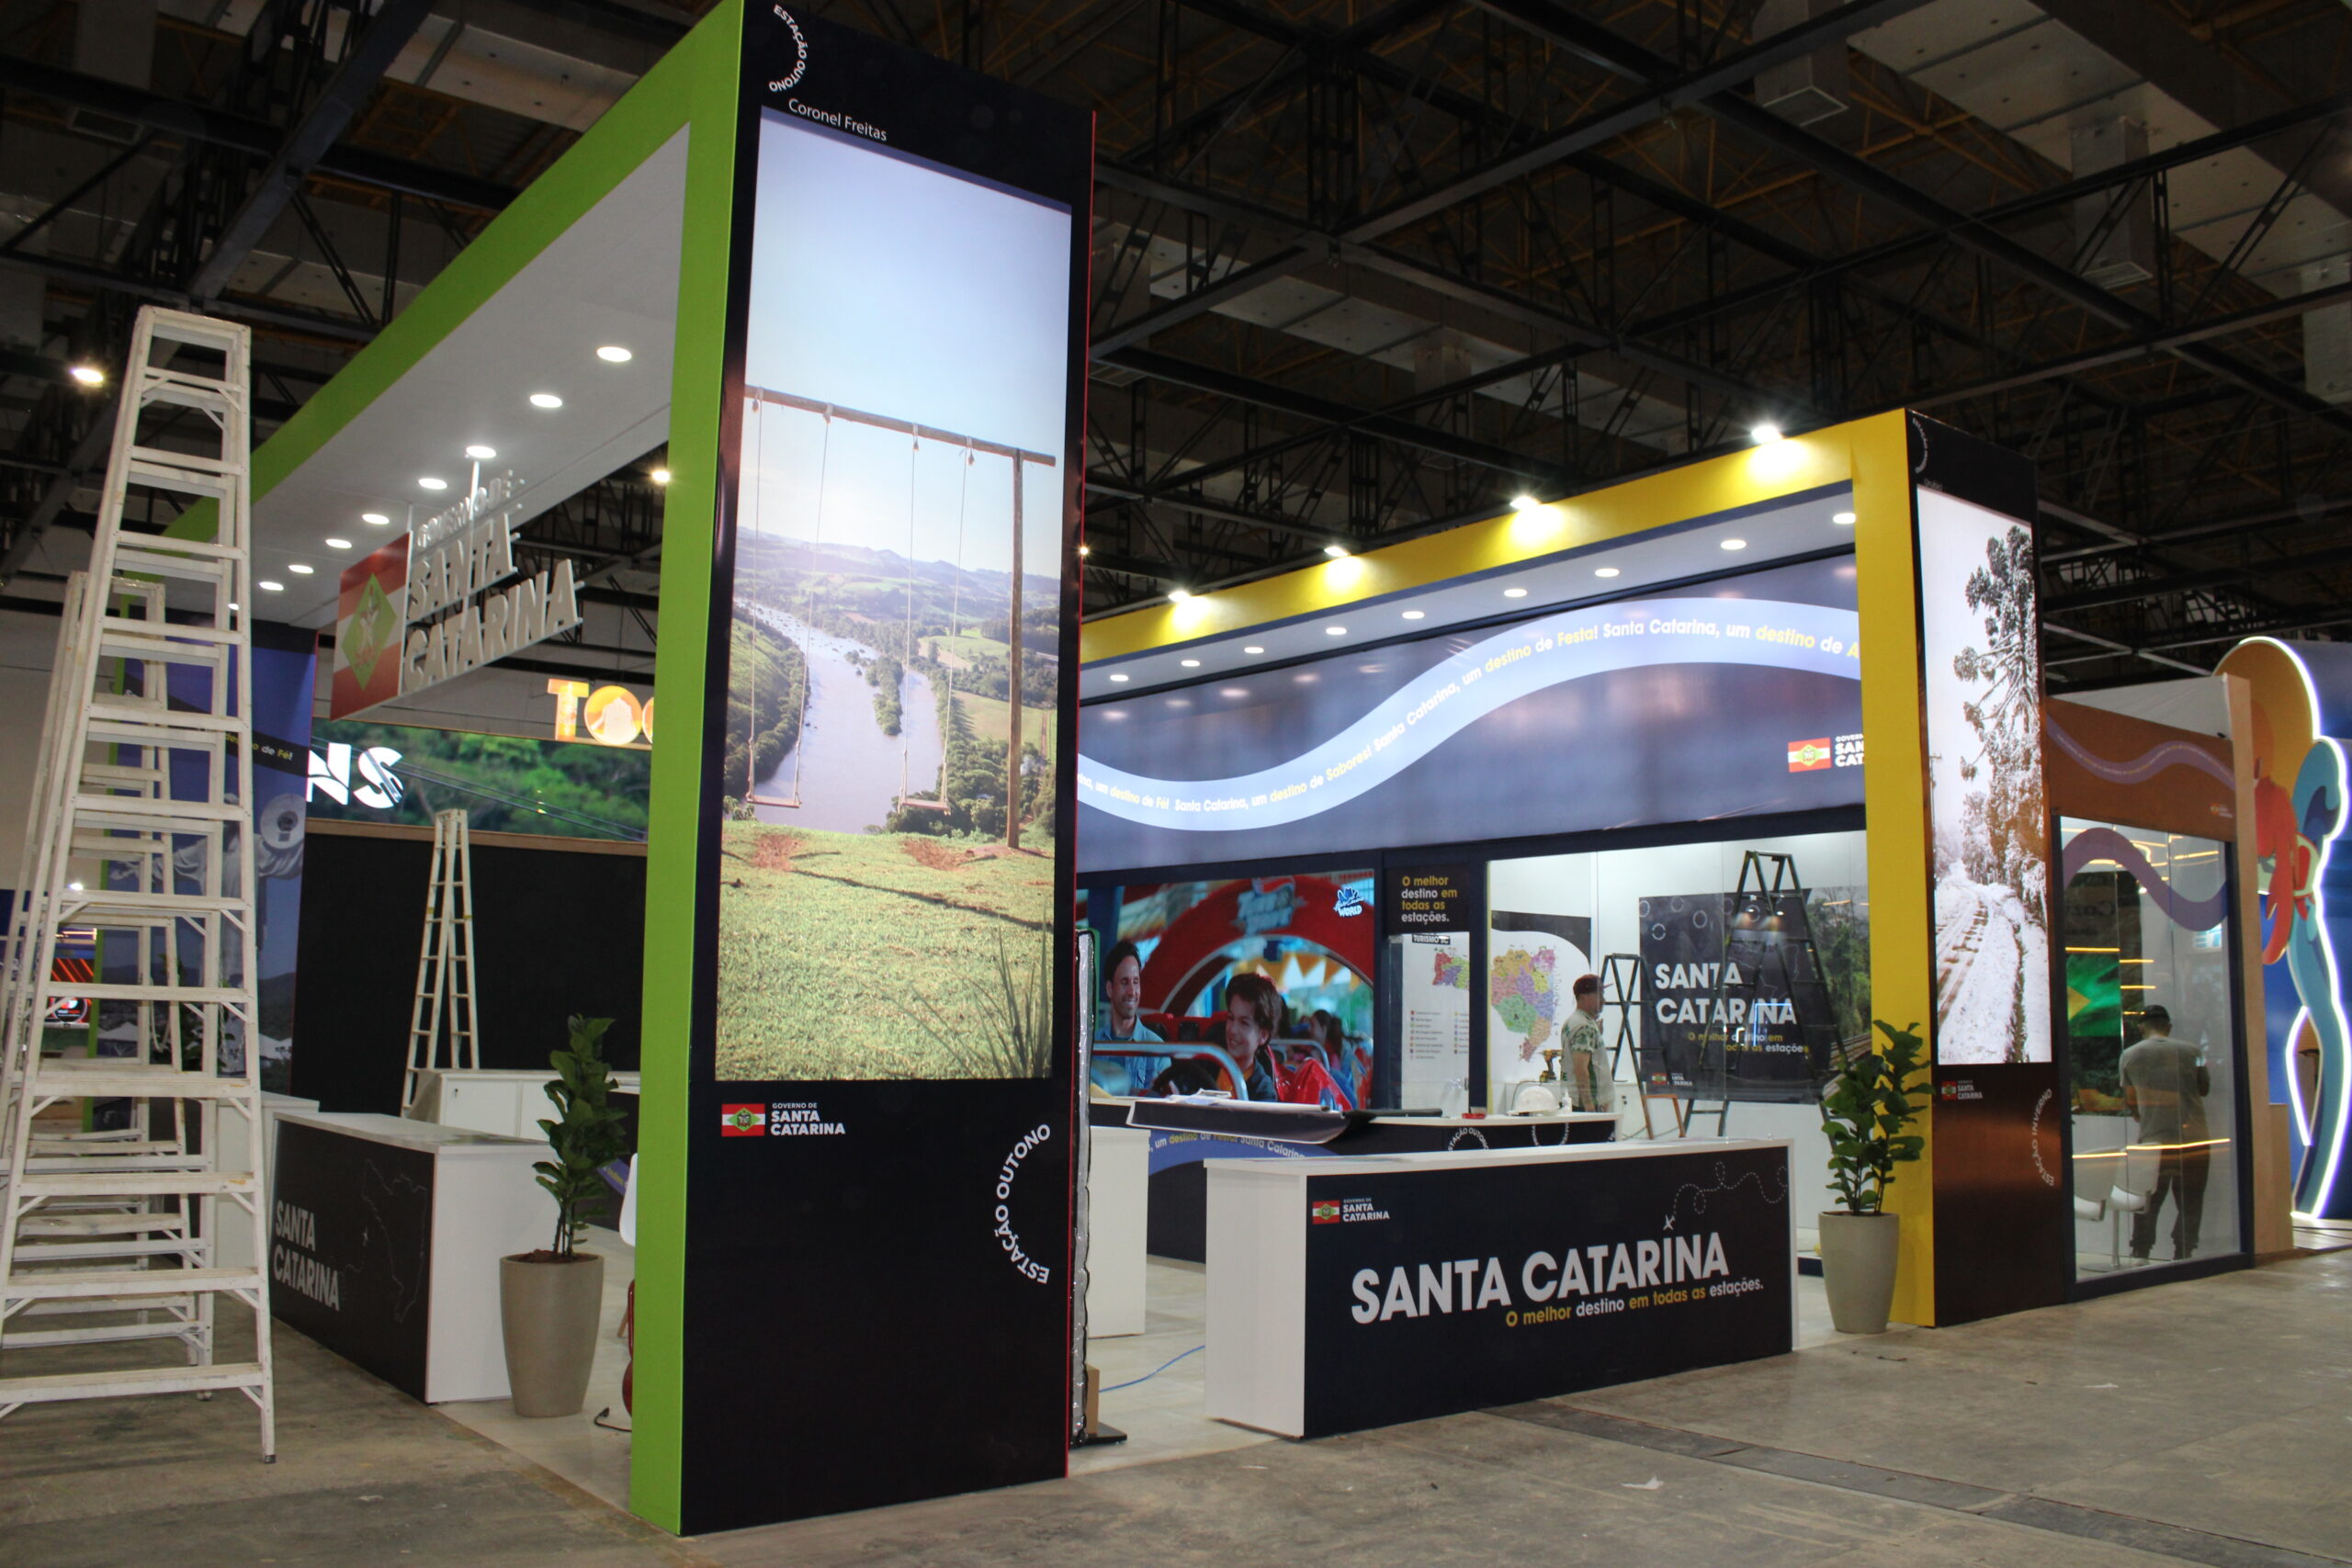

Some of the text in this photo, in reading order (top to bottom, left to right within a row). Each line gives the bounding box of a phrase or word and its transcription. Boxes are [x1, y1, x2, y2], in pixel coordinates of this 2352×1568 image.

[769, 4, 808, 92] ESTAÇÃO OUTONO
[787, 98, 888, 141] Coronel Freitas
[407, 513, 514, 621] SANTA
[402, 558, 579, 691] CATARINA
[548, 678, 654, 745] TO
[1110, 786, 1140, 804] destino
[1142, 795, 1154, 807] de
[1156, 795, 1170, 809] Fé!
[1175, 798, 1201, 812] Santa
[1204, 797, 1249, 812] Catarina,
[1251, 794, 1267, 807] um
[1270, 783, 1307, 802] destino
[1309, 774, 1324, 789] de
[1326, 745, 1373, 781] Sabores!
[1373, 722, 1406, 751] Santa
[1407, 682, 1461, 725] Catarina,
[1462, 667, 1482, 685] um
[1485, 645, 1532, 672] destino
[1535, 637, 1554, 653] de
[1556, 625, 1599, 647] Festa!
[1602, 620, 1645, 638] Santa
[1649, 619, 1720, 638] Catarina,
[1725, 624, 1750, 638] um
[1756, 625, 1815, 649] destino
[1820, 635, 1843, 654] de
[261, 745, 276, 757] de
[1402, 875, 1449, 886] O melhor
[1401, 888, 1458, 899] destino em
[1338, 904, 1363, 918] WORLD
[1401, 900, 1445, 910] todas as
[1401, 911, 1450, 926] estações.
[1655, 962, 1743, 989] SANTA
[1768, 1034, 1783, 1043] em
[1957, 1091, 1983, 1100] CATARINA
[771, 1110, 820, 1122] SANTA
[770, 1122, 845, 1136] CATARINA
[1155, 1137, 1167, 1149] um
[994, 1124, 1051, 1284] ESTAÇÃO OUTONO
[1342, 1203, 1374, 1213] SANTA
[1342, 1211, 1390, 1223] CATARINA
[276, 1200, 316, 1251] SANTA
[274, 1244, 340, 1312] CATARINA
[1351, 1231, 1730, 1325] SANTA CATARINA
[1506, 1277, 1764, 1327] O melhor destino em todas as estações.
